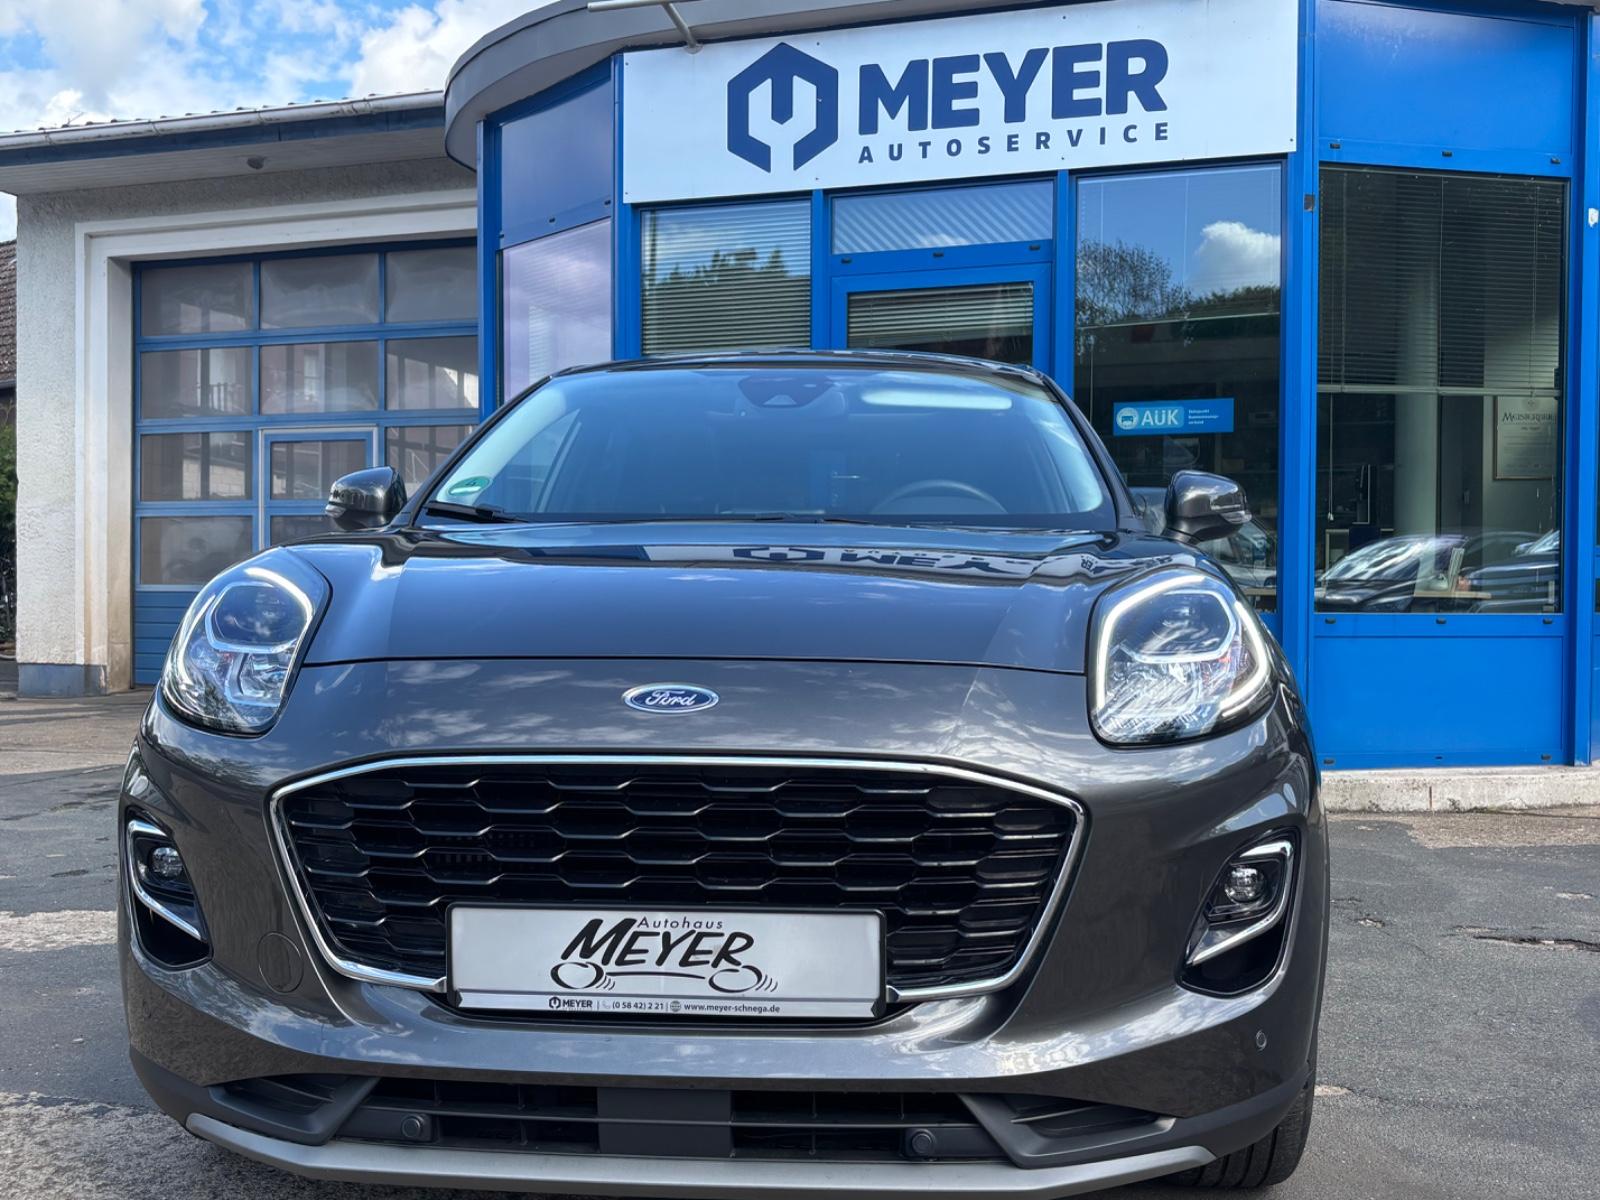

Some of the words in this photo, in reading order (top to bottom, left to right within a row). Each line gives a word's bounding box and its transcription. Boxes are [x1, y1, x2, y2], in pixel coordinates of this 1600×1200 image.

[858, 38, 1169, 135] MEYER
[858, 122, 1168, 164] AUTOSERVICE
[645, 689, 698, 706] Ford
[637, 916, 724, 929] Autohaus
[560, 917, 755, 969] MEYER
[562, 999, 593, 1008] MEYER
[684, 1003, 780, 1014] www.meyer-schnega.de
